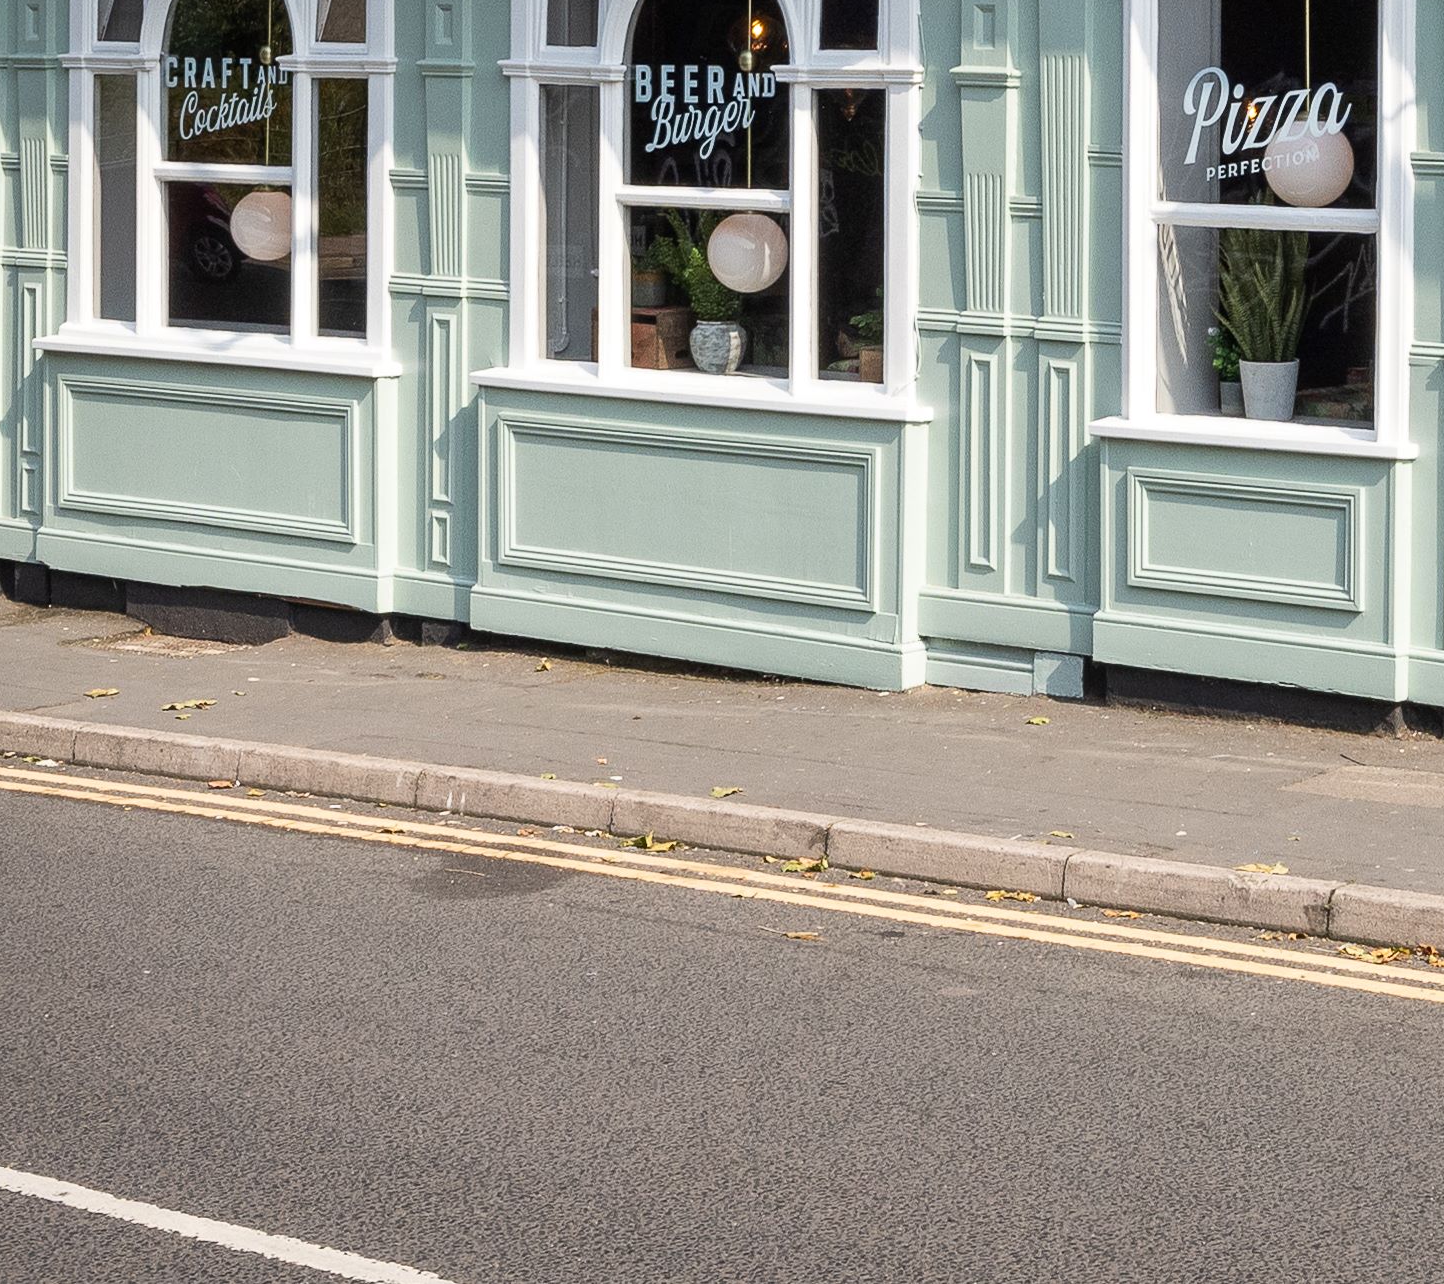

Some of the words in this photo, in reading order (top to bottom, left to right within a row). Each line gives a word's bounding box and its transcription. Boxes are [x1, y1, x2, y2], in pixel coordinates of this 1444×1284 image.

[164, 56, 253, 90] CRAFT
[257, 65, 288, 85] AND
[635, 64, 725, 104] BEER
[732, 72, 777, 98] AND
[179, 82, 278, 140] Cocktails
[645, 93, 756, 160] Burger
[1182, 66, 1353, 165] Pizza
[1206, 147, 1320, 182] PERFECTION
